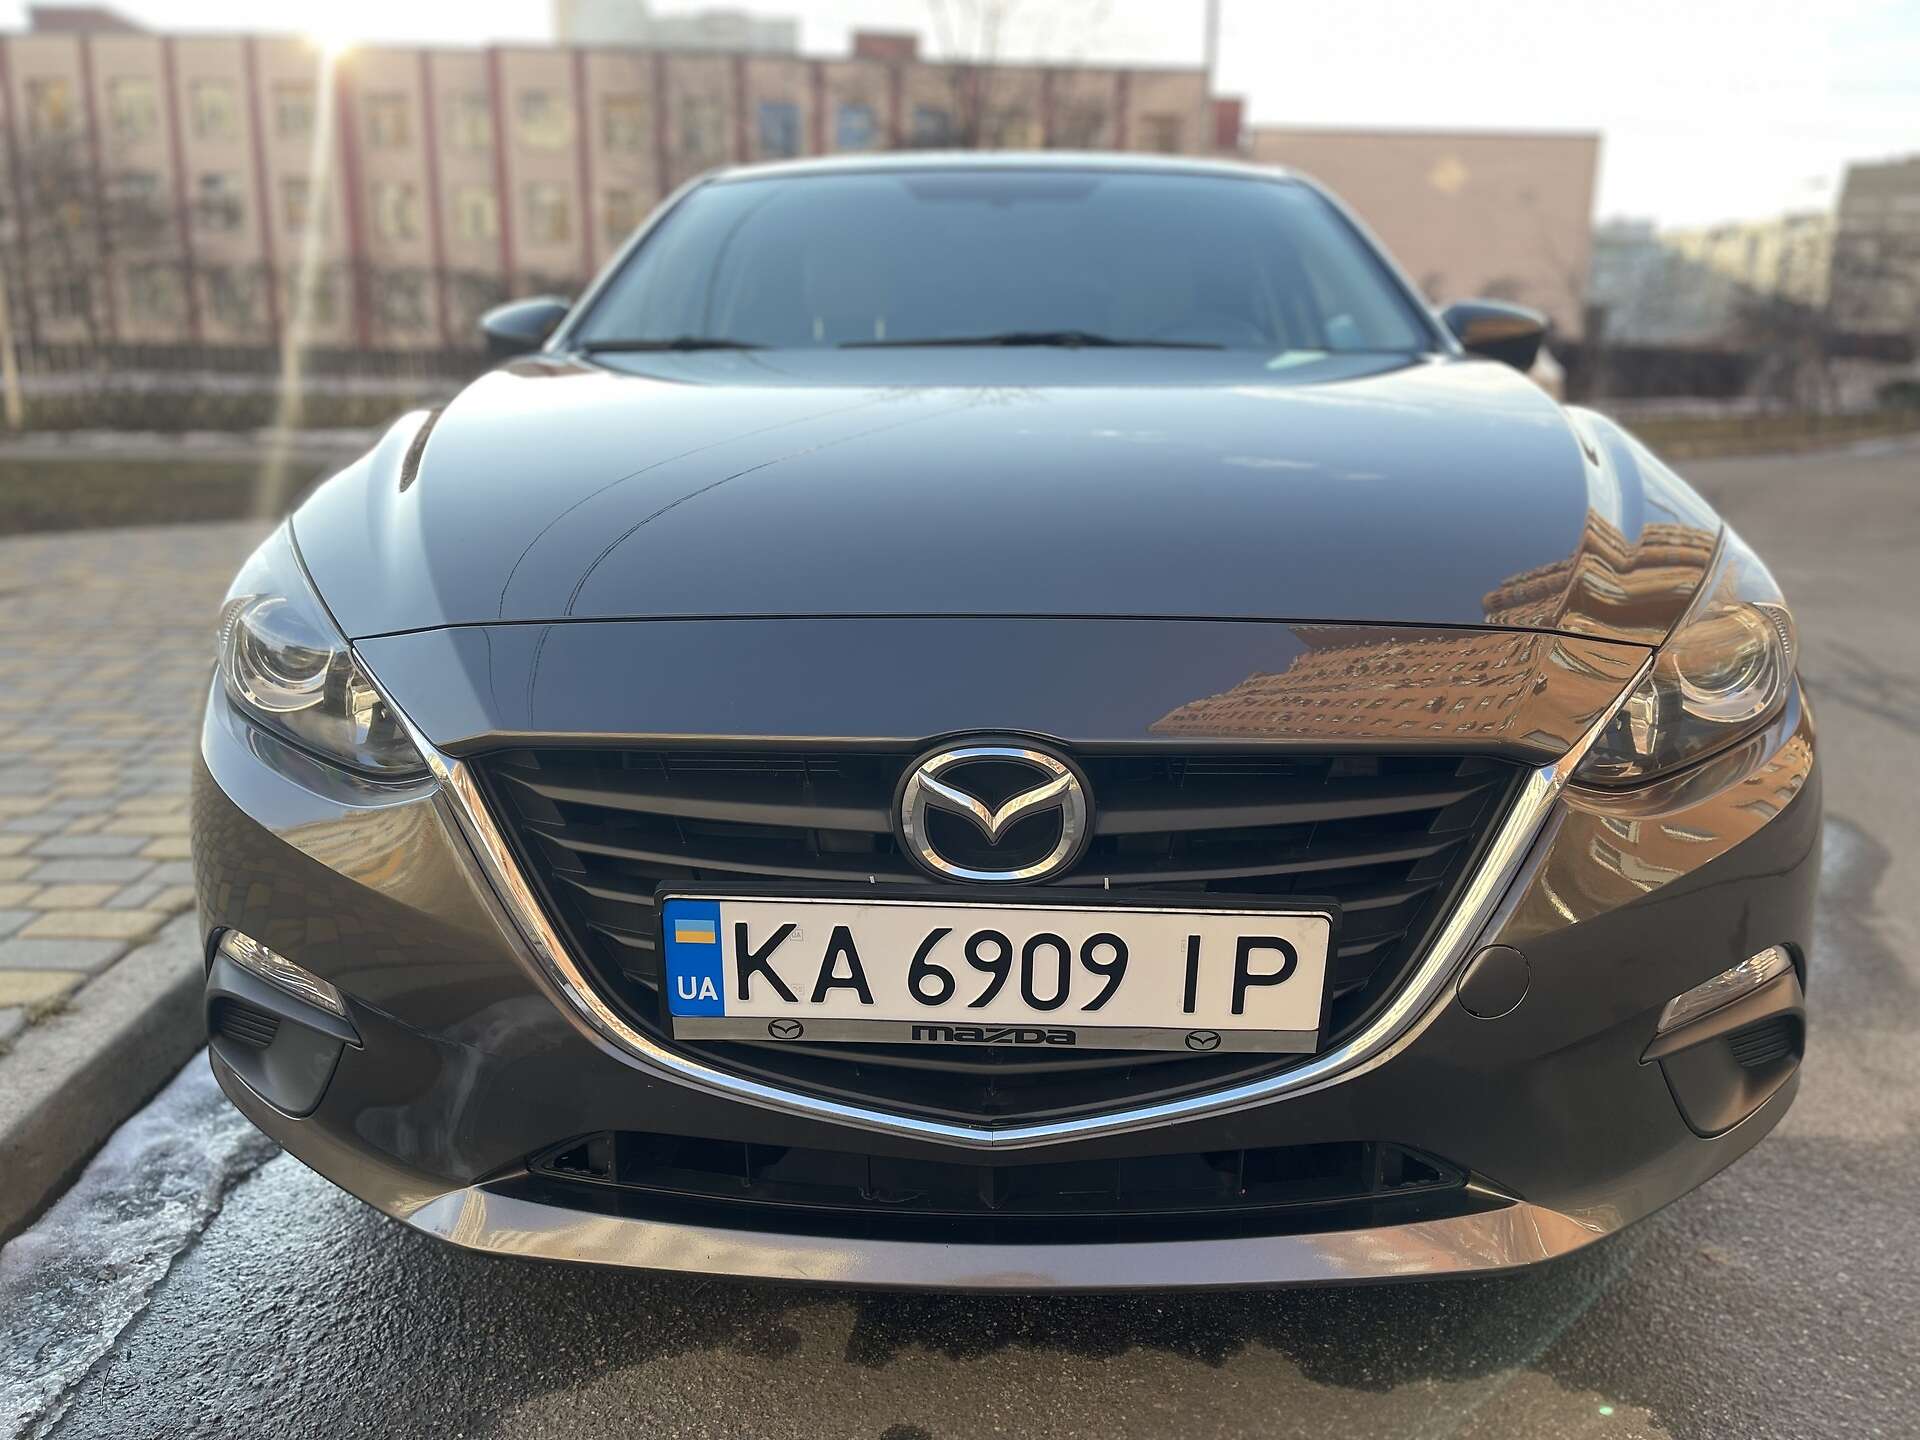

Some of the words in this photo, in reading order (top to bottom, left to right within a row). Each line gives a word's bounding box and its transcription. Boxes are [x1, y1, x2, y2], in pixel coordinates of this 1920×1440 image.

[678, 976, 718, 1000] UA
[734, 922, 874, 1004] KA
[908, 928, 1128, 1011] 6909
[1183, 935, 1297, 1014] IP
